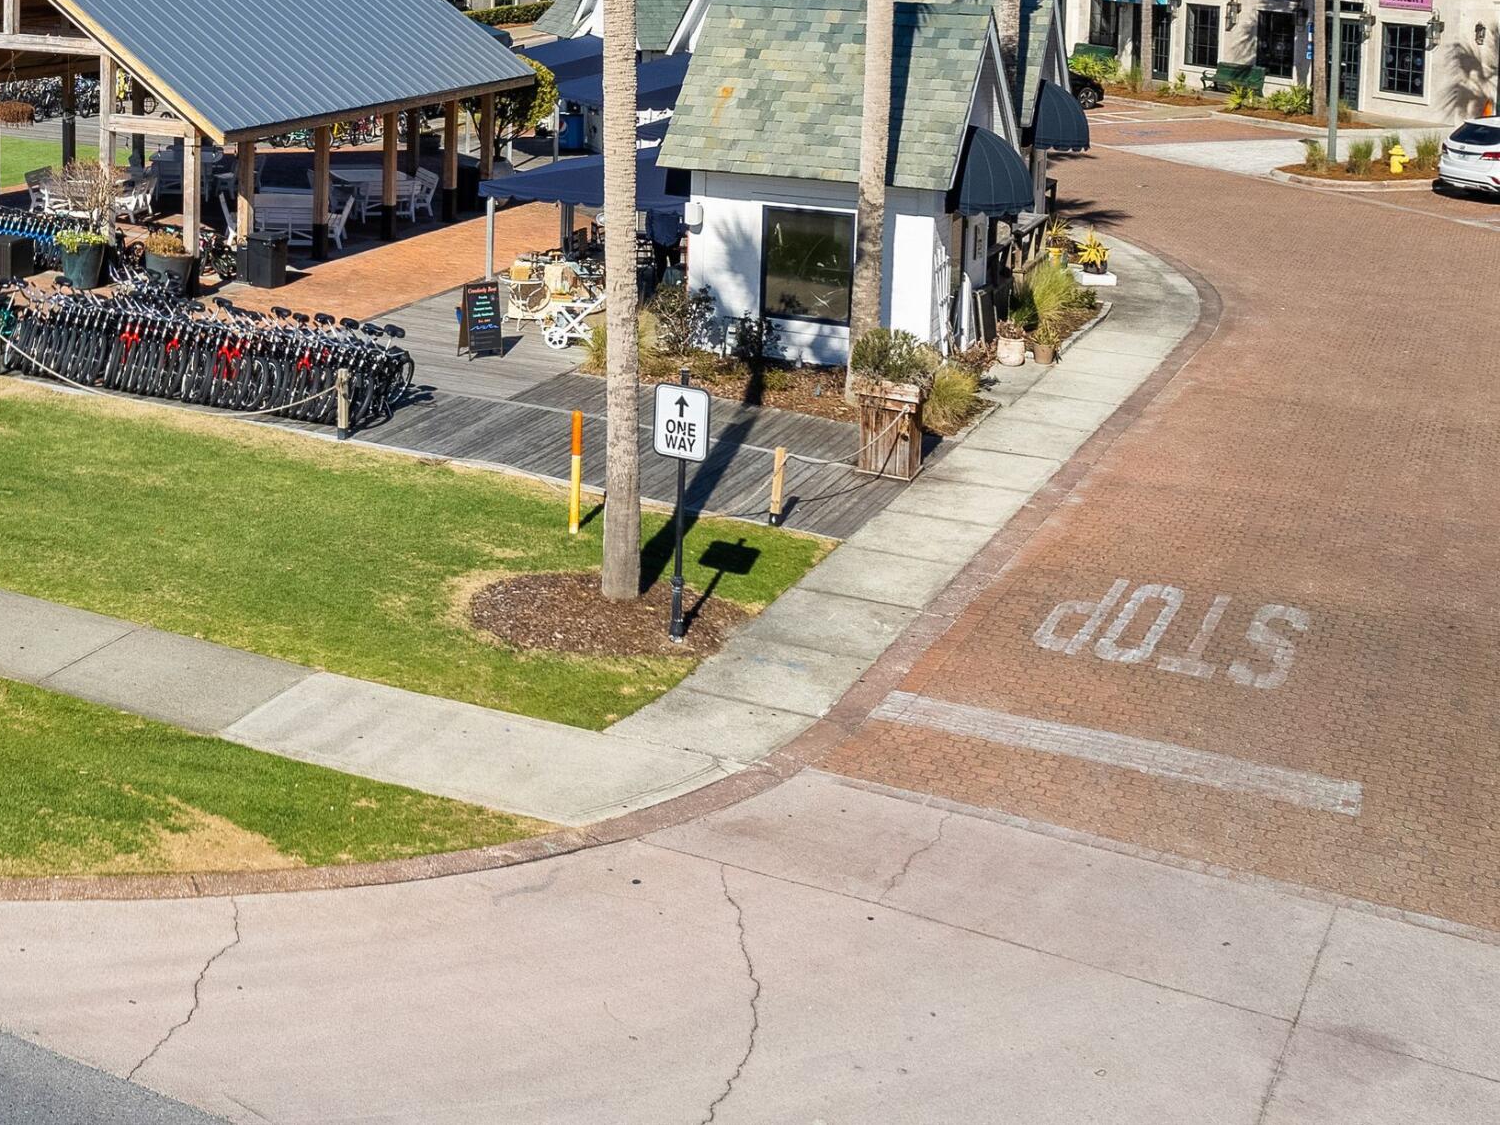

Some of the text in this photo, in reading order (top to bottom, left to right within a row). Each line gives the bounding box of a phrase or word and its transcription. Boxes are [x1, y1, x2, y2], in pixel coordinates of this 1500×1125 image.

[665, 418, 697, 438] ONE
[664, 433, 697, 453] WAY
[1032, 578, 1310, 690] STOP
